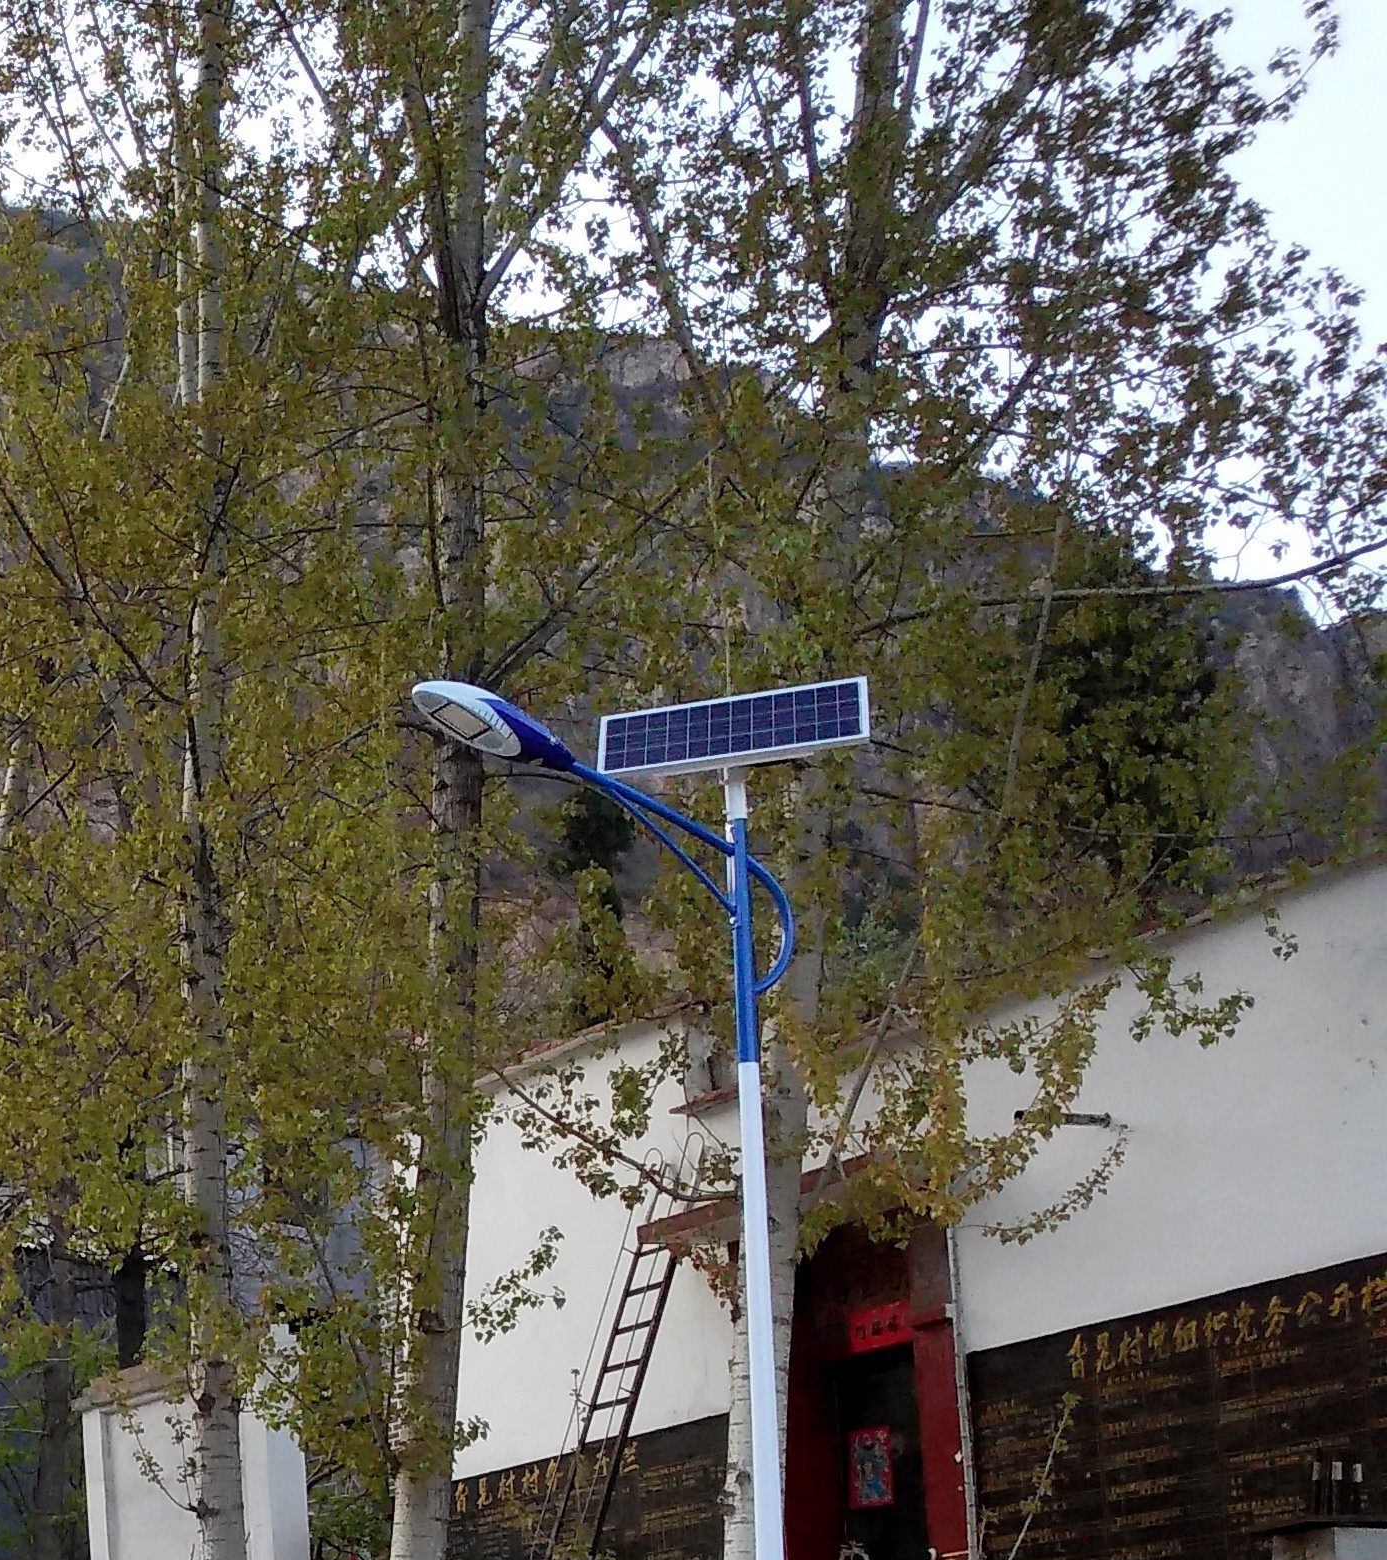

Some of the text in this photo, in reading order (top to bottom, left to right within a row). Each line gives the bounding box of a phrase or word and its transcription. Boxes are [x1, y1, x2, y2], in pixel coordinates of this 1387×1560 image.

[454, 1440, 641, 1513] 旮旯村村务开栏
